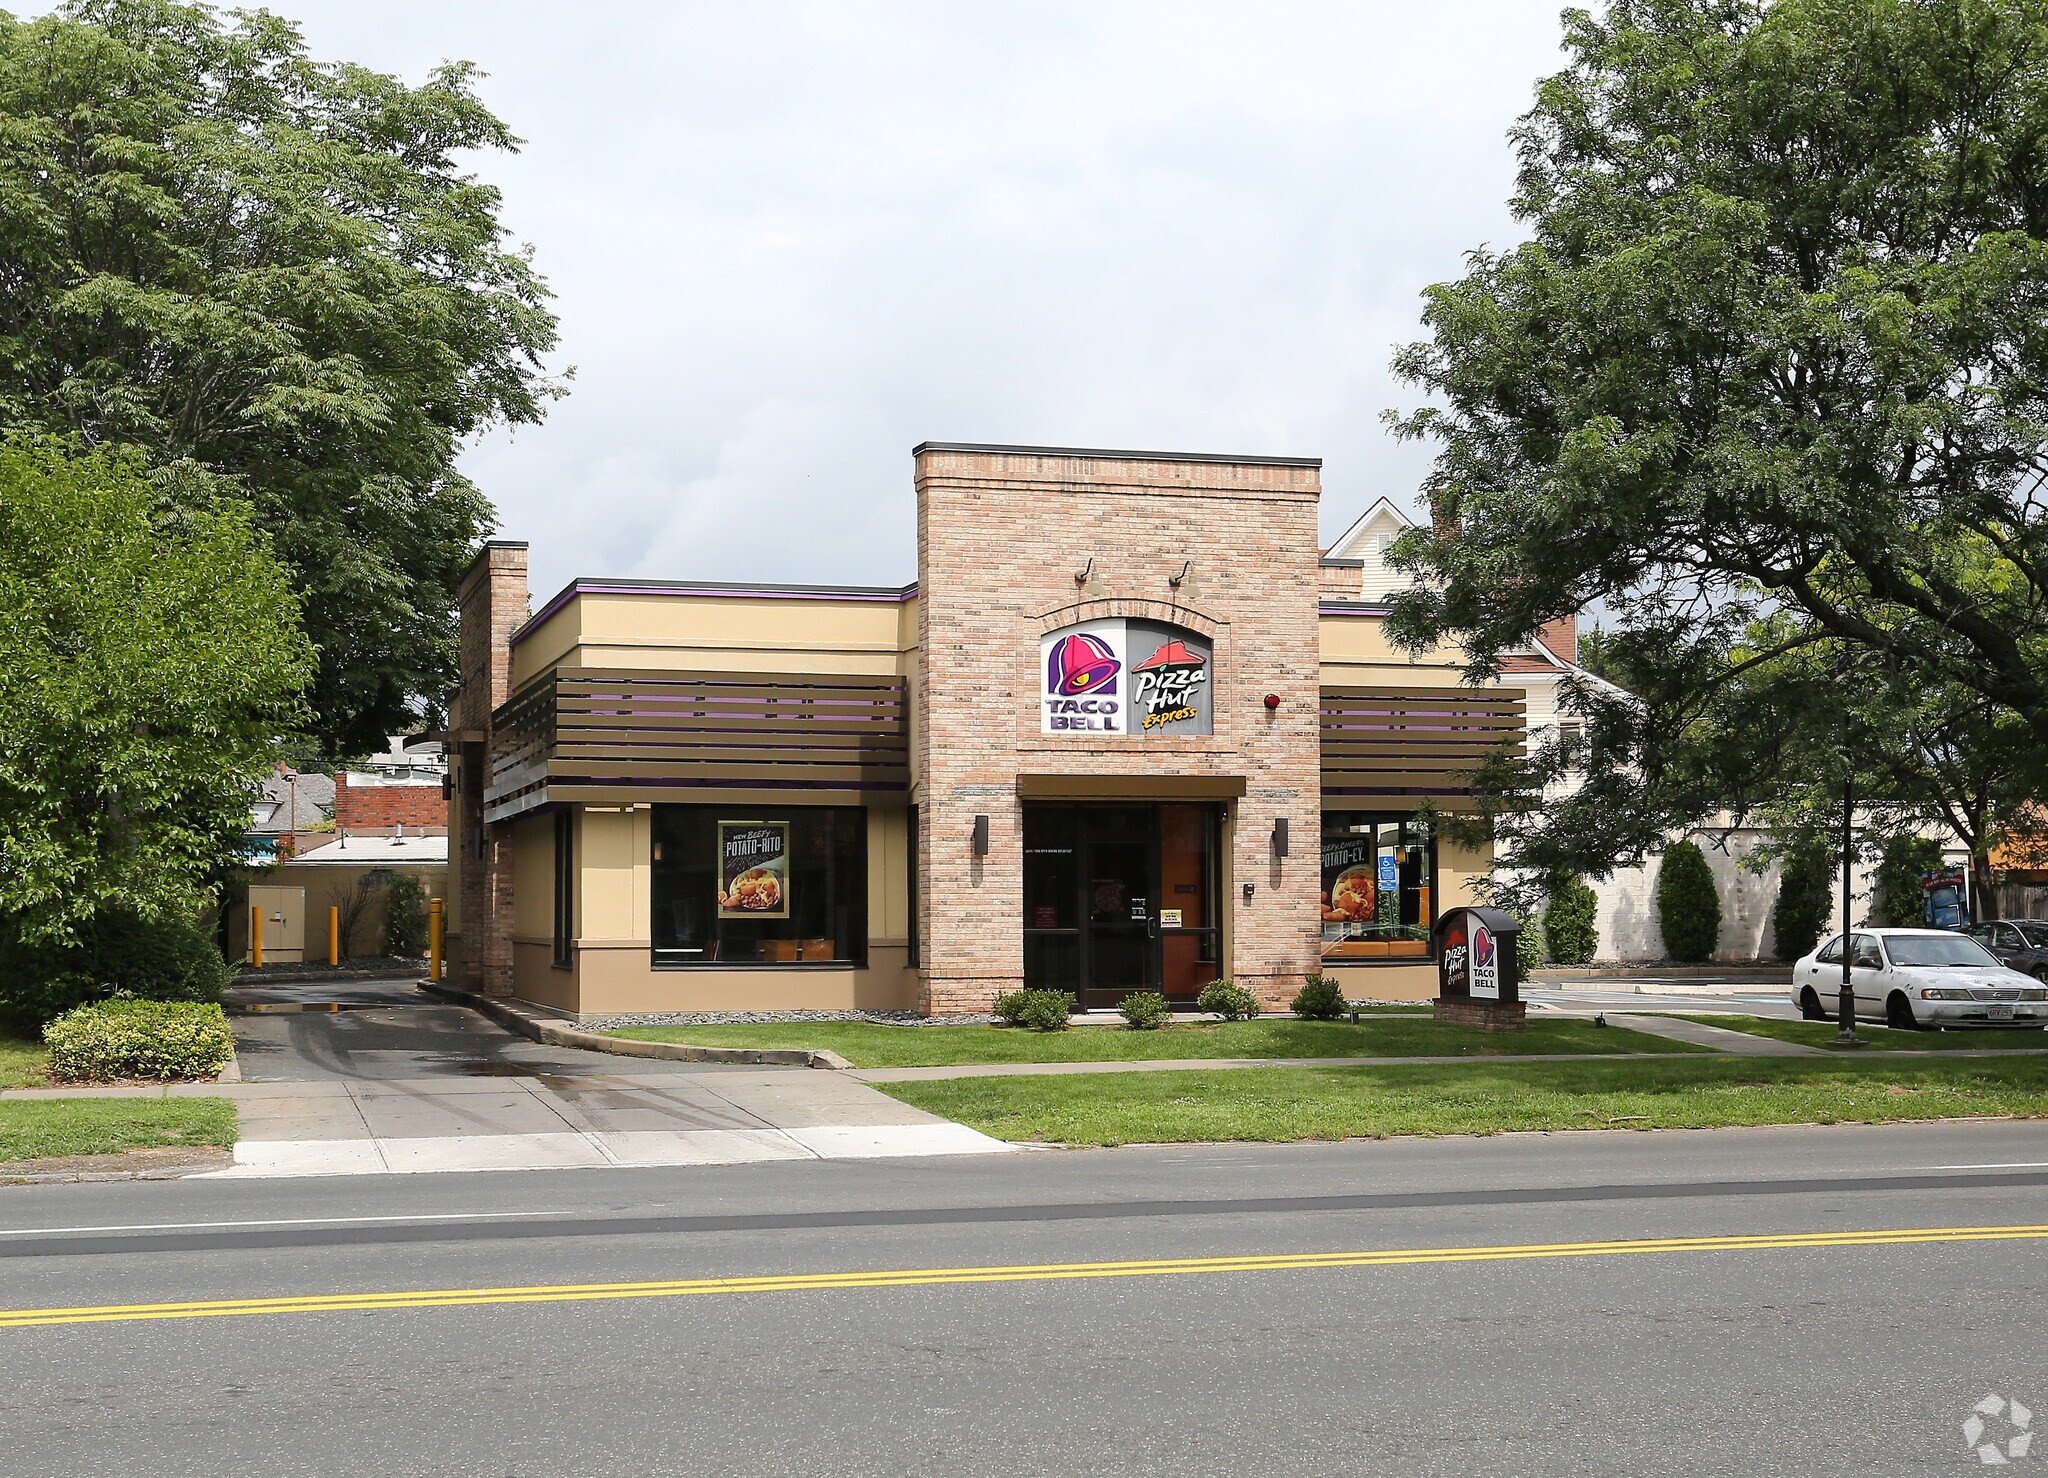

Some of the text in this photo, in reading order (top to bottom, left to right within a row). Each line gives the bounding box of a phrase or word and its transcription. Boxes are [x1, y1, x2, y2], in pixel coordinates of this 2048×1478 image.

[1134, 664, 1206, 703] Pizza
[1045, 700, 1119, 714] TACO
[1146, 685, 1199, 712] Hut
[1050, 716, 1120, 731] BELL
[1142, 707, 1197, 729] Express
[747, 829, 771, 840] BEEFY
[726, 836, 781, 857] POTATO-RITO
[1444, 944, 1467, 970] Pizza
[1448, 957, 1465, 976] Hut
[1473, 968, 1495, 978] TACO
[1447, 971, 1465, 986] Express
[1474, 979, 1496, 988] BELL
